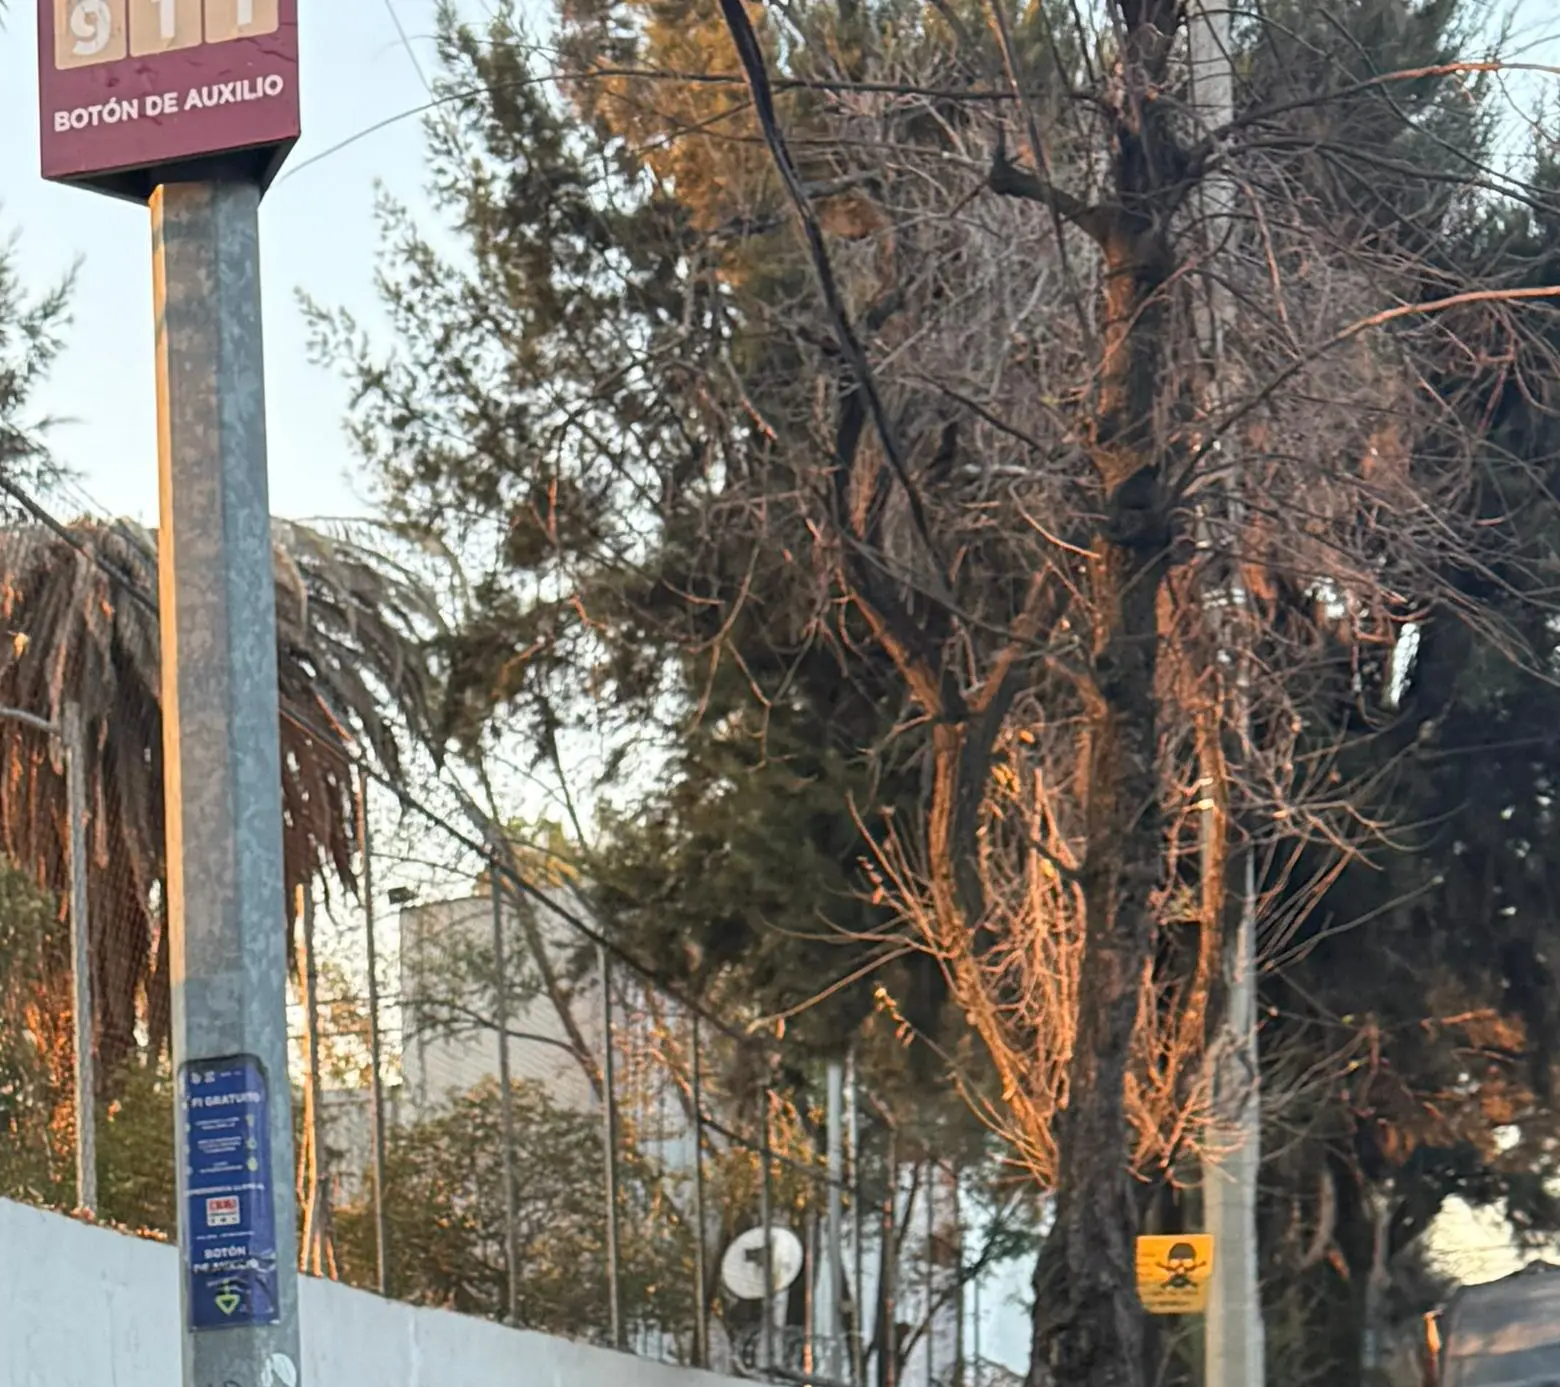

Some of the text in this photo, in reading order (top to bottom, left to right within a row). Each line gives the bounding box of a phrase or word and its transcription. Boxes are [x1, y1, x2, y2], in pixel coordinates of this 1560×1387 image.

[53, 74, 284, 132] BOTÓN DE AUXILIO
